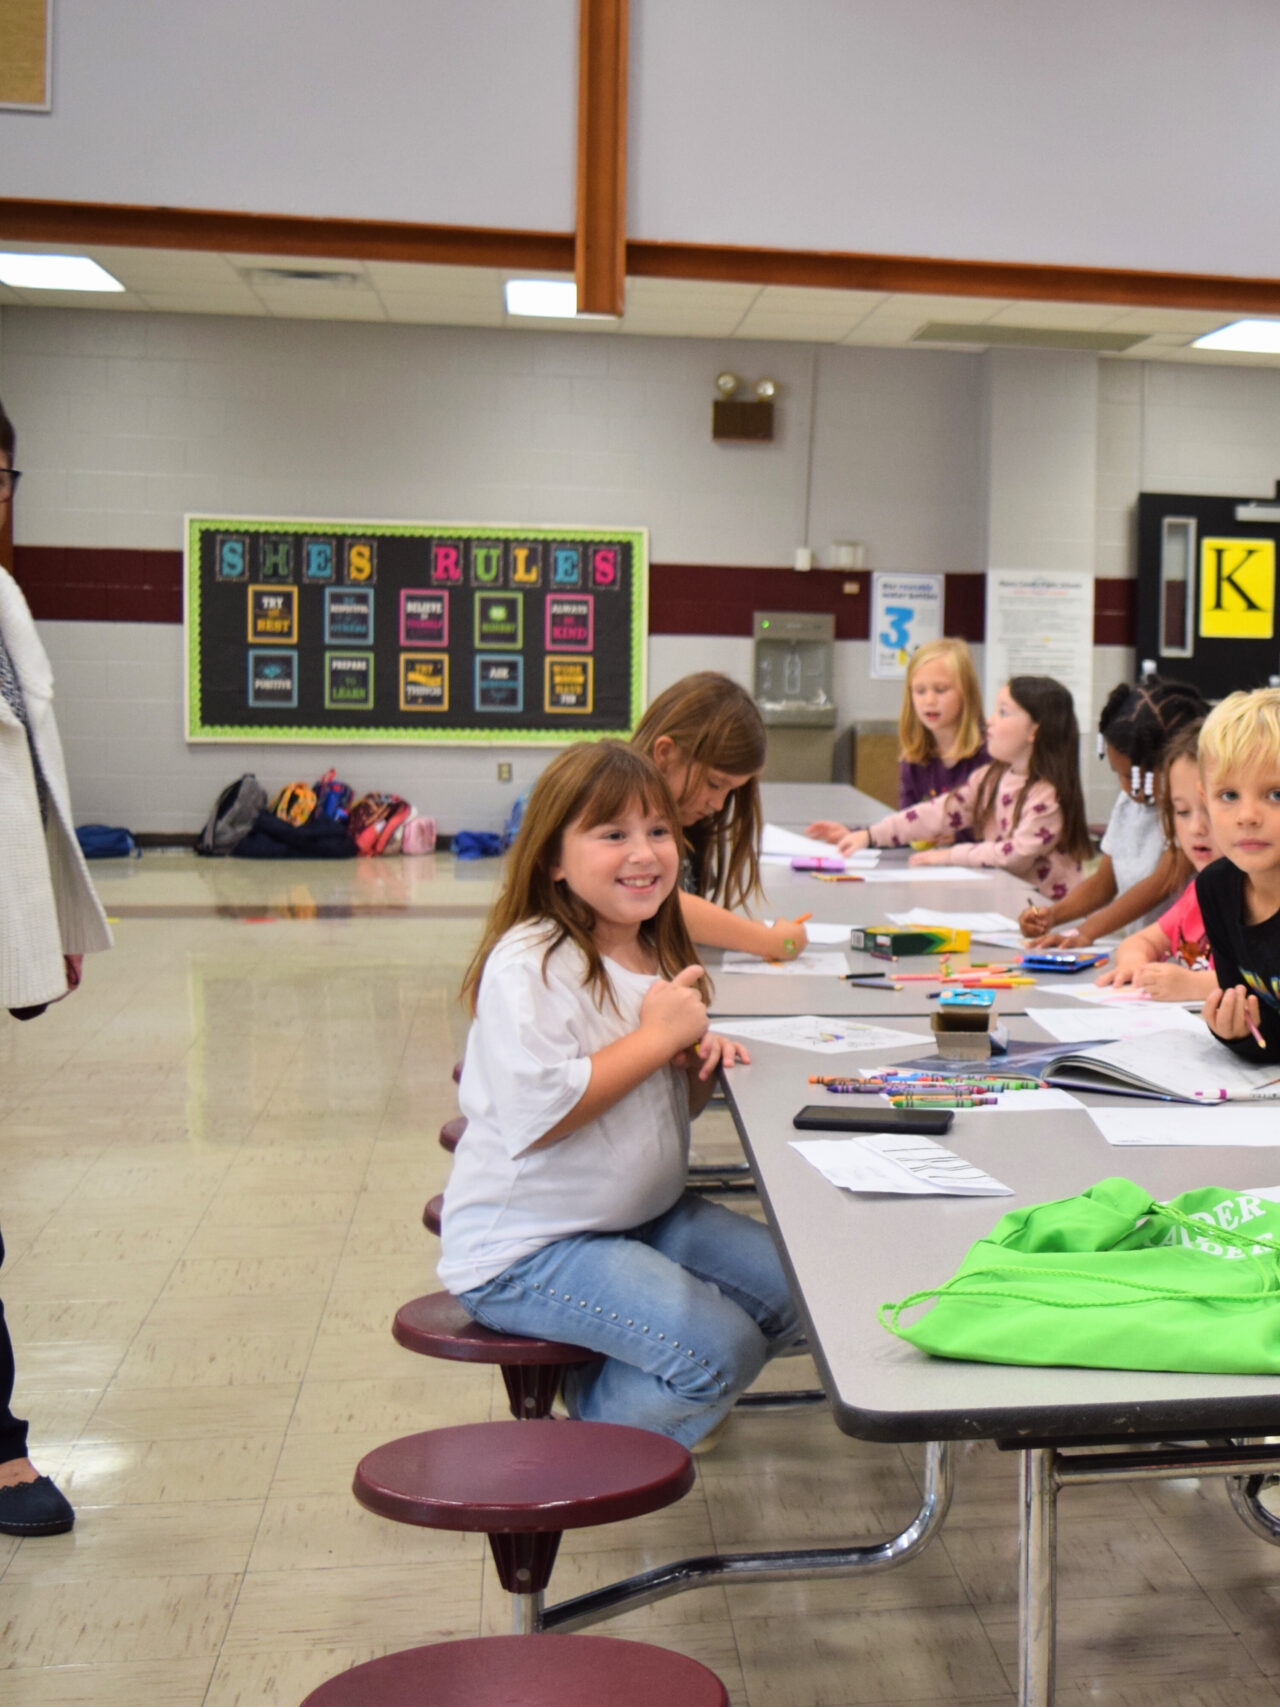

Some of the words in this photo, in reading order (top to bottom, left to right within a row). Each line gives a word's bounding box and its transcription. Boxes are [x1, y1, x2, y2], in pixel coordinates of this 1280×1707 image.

[222, 540, 371, 581] SHES
[433, 545, 616, 585] RULES
[1207, 547, 1269, 613] K
[552, 626, 588, 640] KIND
[879, 605, 915, 650] 3
